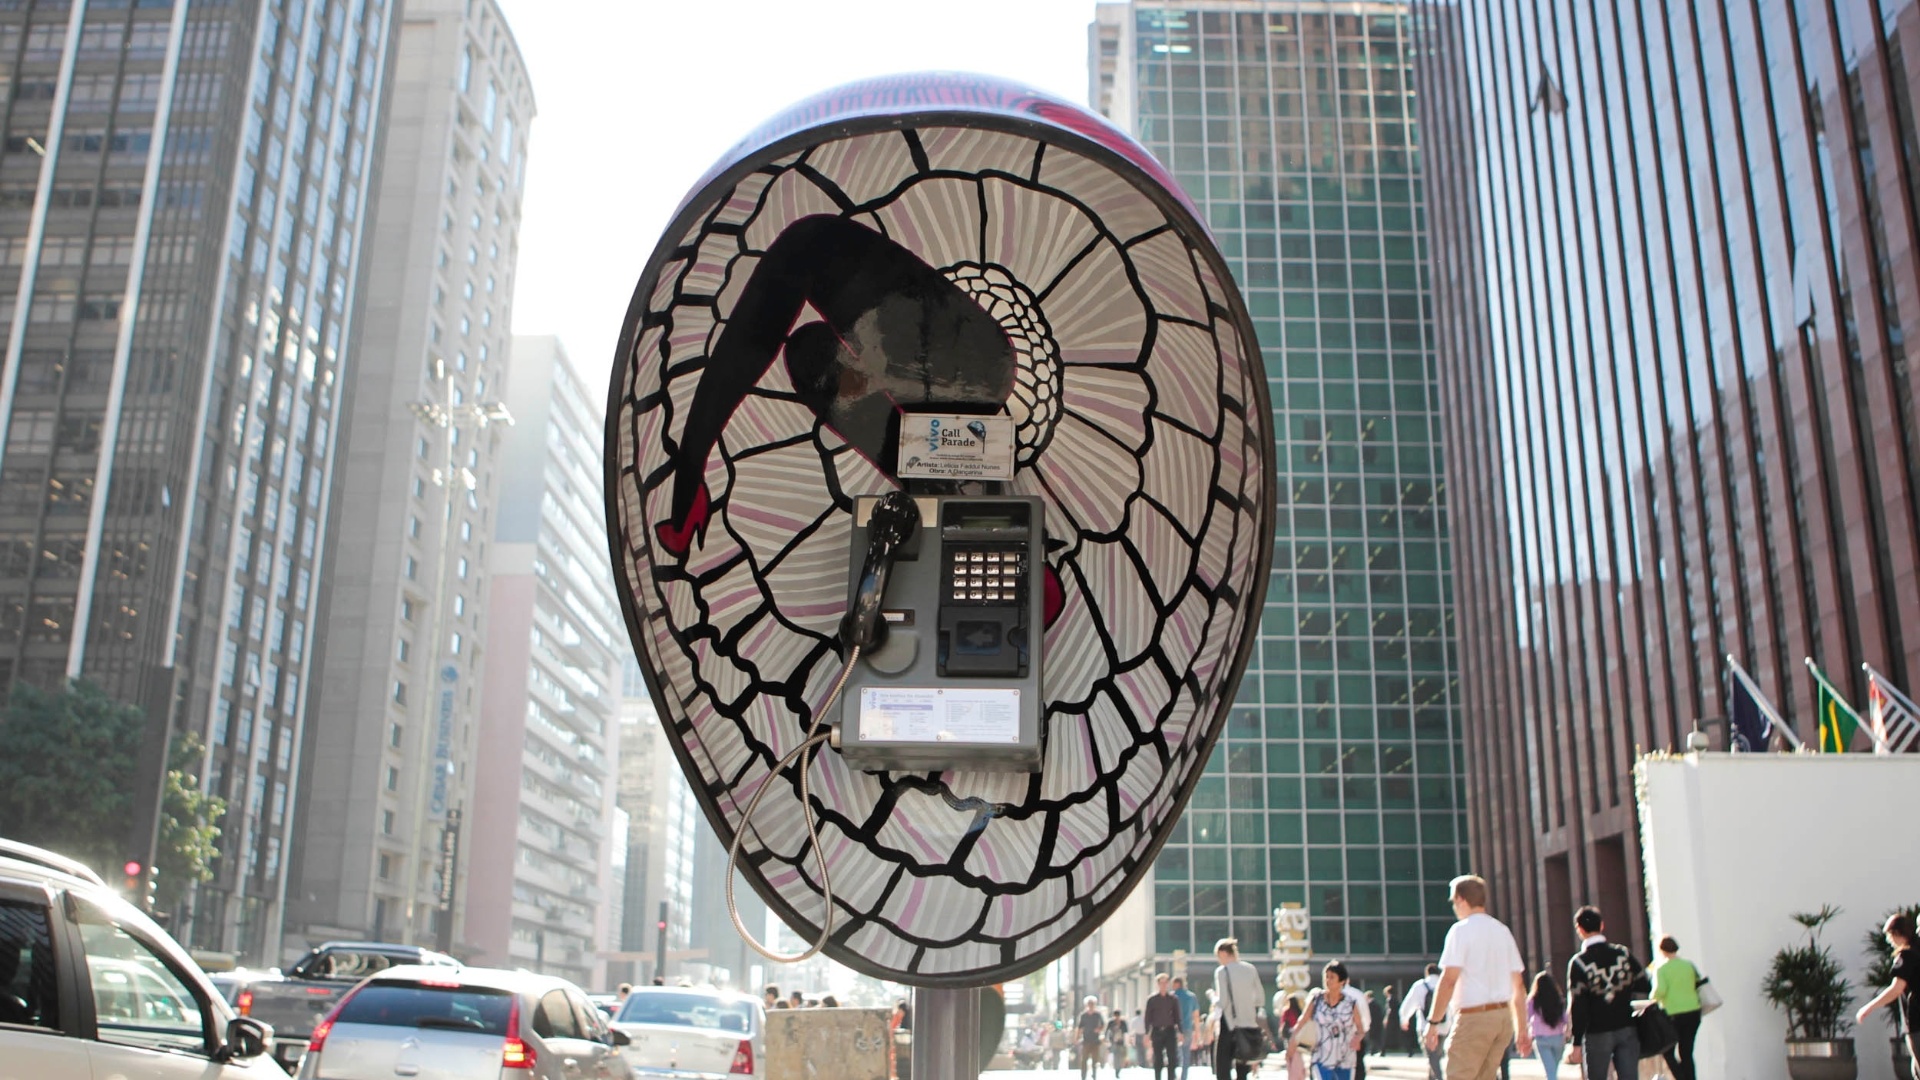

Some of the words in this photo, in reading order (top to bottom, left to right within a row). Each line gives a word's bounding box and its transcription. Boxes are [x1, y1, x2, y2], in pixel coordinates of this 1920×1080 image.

[926, 419, 940, 452] vivo
[941, 428, 960, 437] Call
[941, 437, 975, 447] Parade
